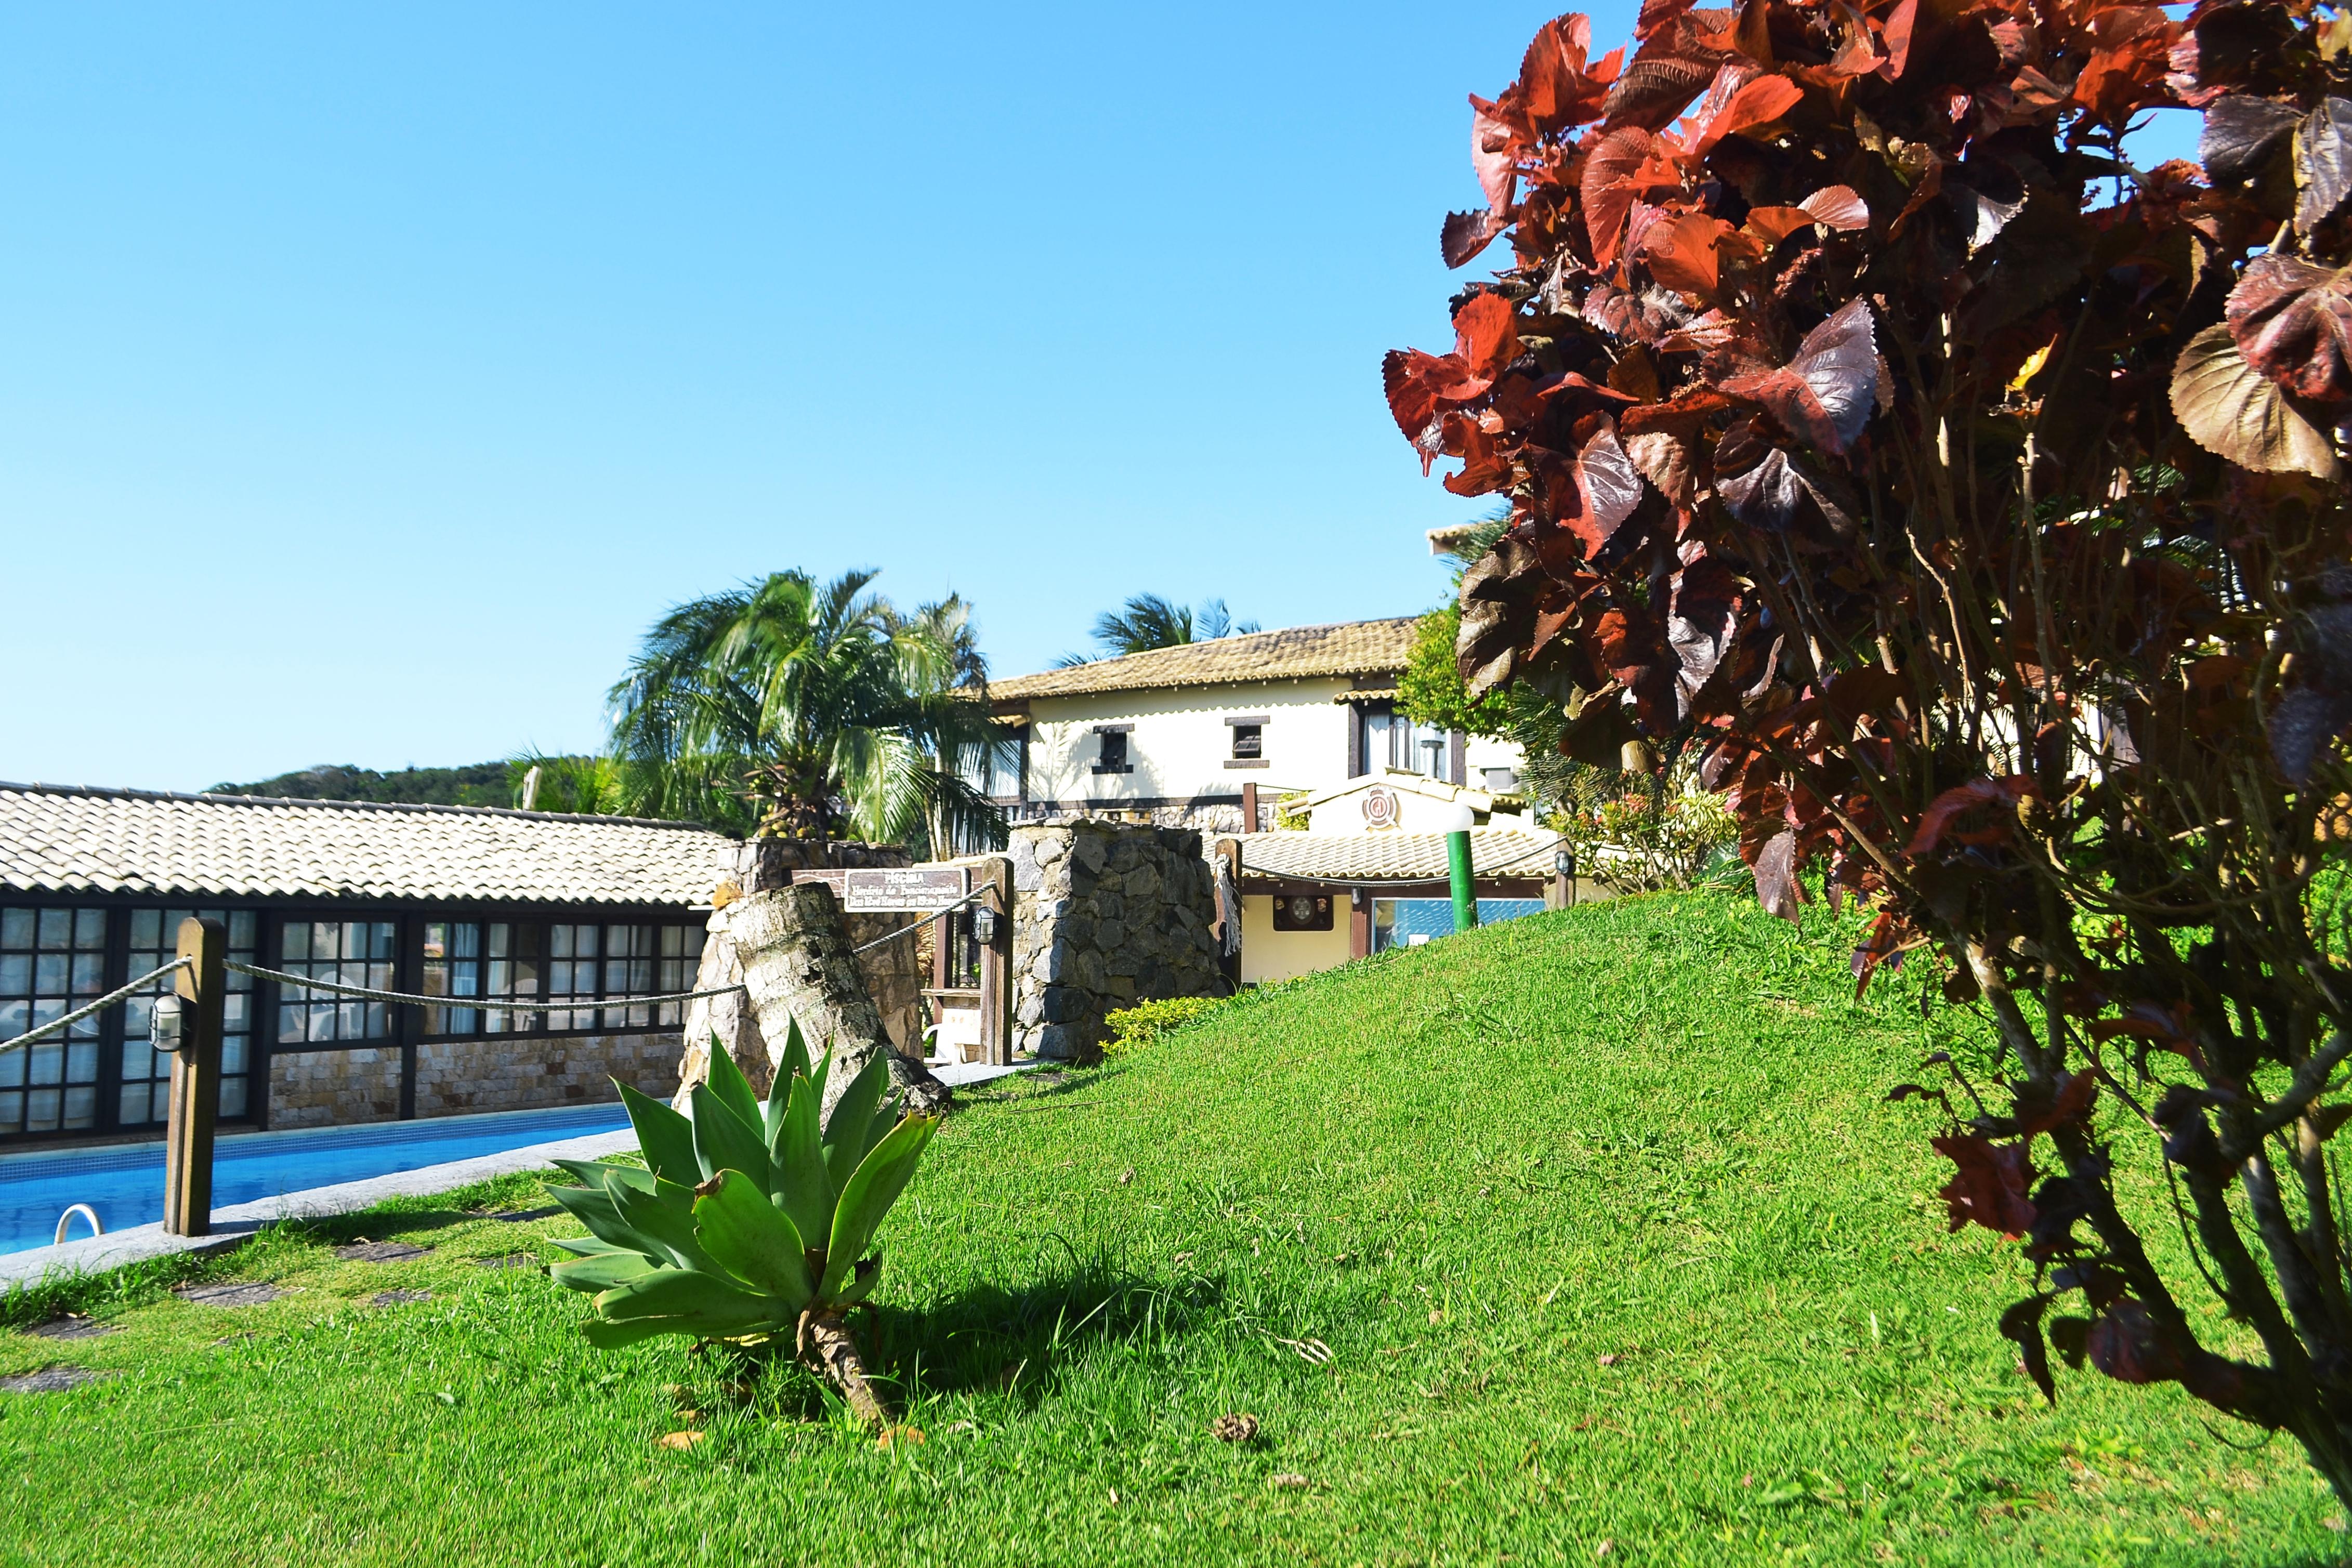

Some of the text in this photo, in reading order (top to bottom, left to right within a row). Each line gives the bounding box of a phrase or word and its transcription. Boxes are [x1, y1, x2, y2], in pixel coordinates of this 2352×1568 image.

[884, 873, 924, 884] PISCINA
[851, 883, 958, 896] Horário de Funcionamento
[849, 896, 864, 907] Das
[881, 895, 905, 907] Horas
